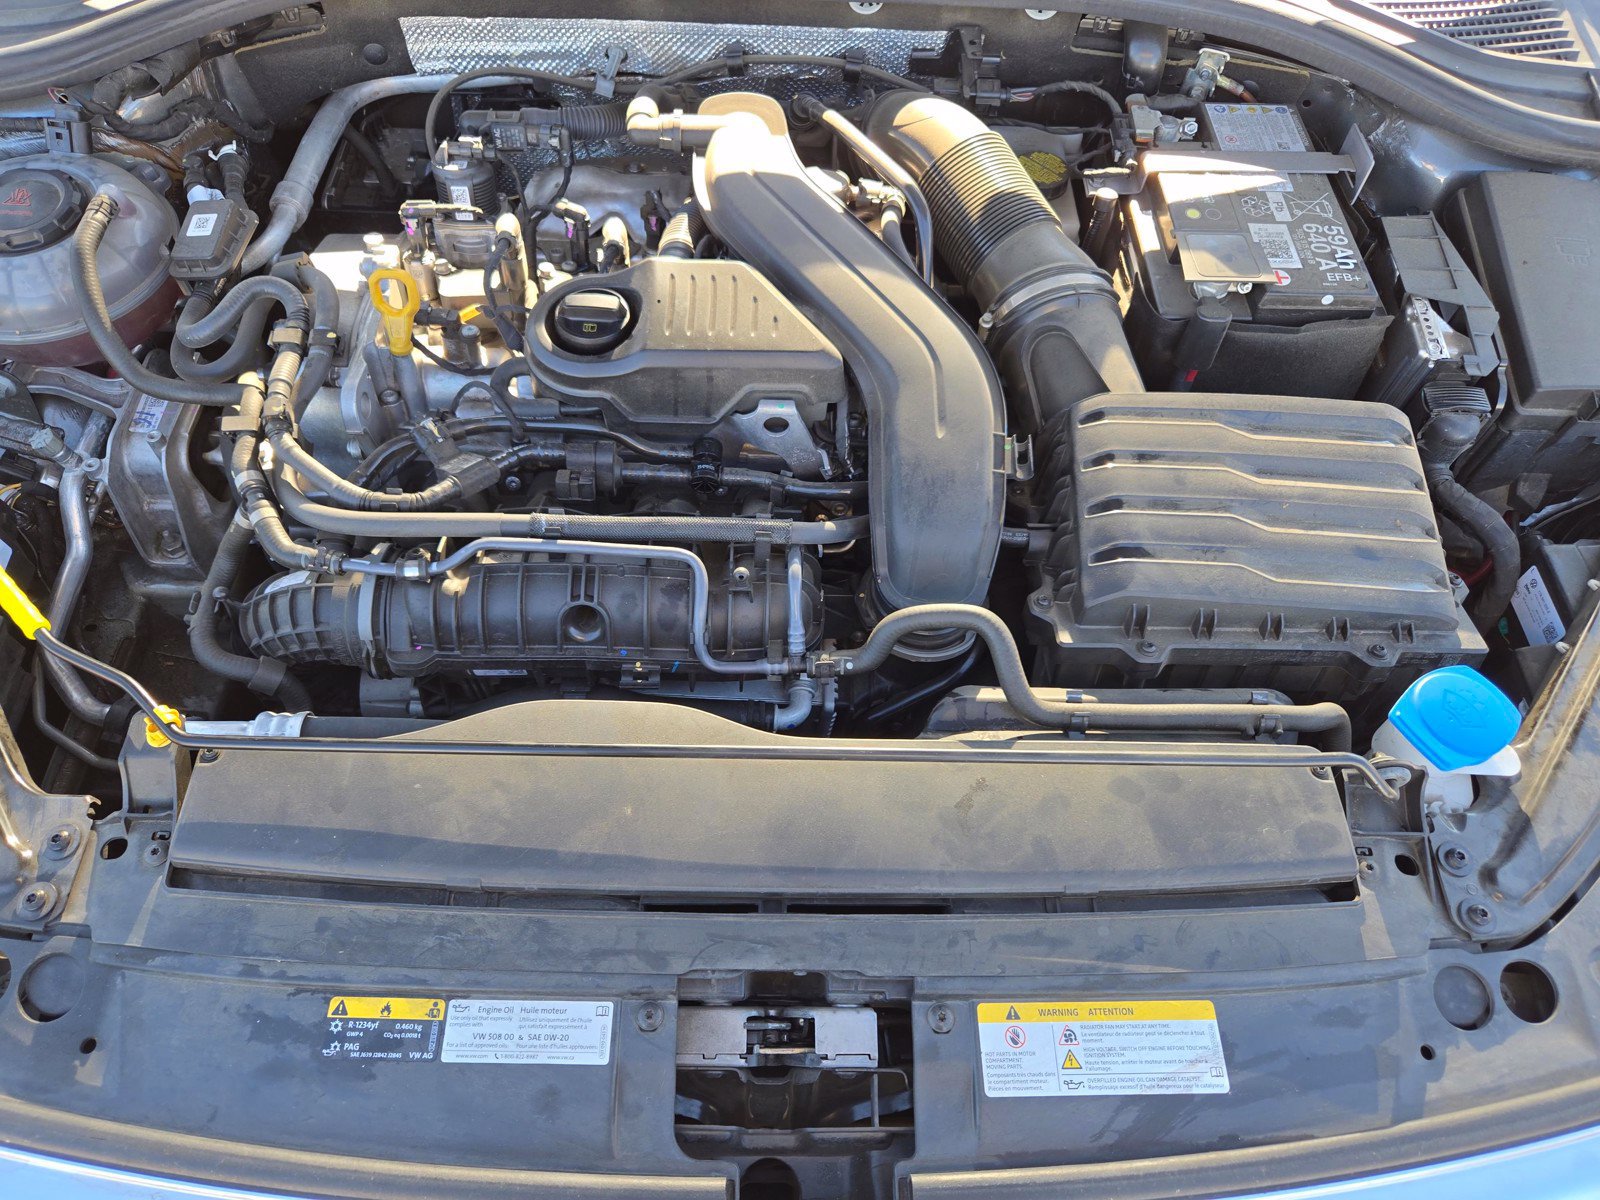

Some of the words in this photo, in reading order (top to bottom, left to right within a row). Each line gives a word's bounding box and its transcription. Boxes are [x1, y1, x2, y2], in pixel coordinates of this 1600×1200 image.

[1273, 202, 1284, 212] Pb
[1302, 224, 1332, 252] 640
[1323, 225, 1358, 270] 59Ah
[1315, 257, 1338, 270] A
[1326, 272, 1362, 282] EFB+
[478, 1006, 502, 1015] Engine
[1038, 1008, 1079, 1017] WARNING
[1088, 1007, 1134, 1016] ATTENTION
[348, 1021, 379, 1030] R-1234yf
[409, 1052, 421, 1060] VW
